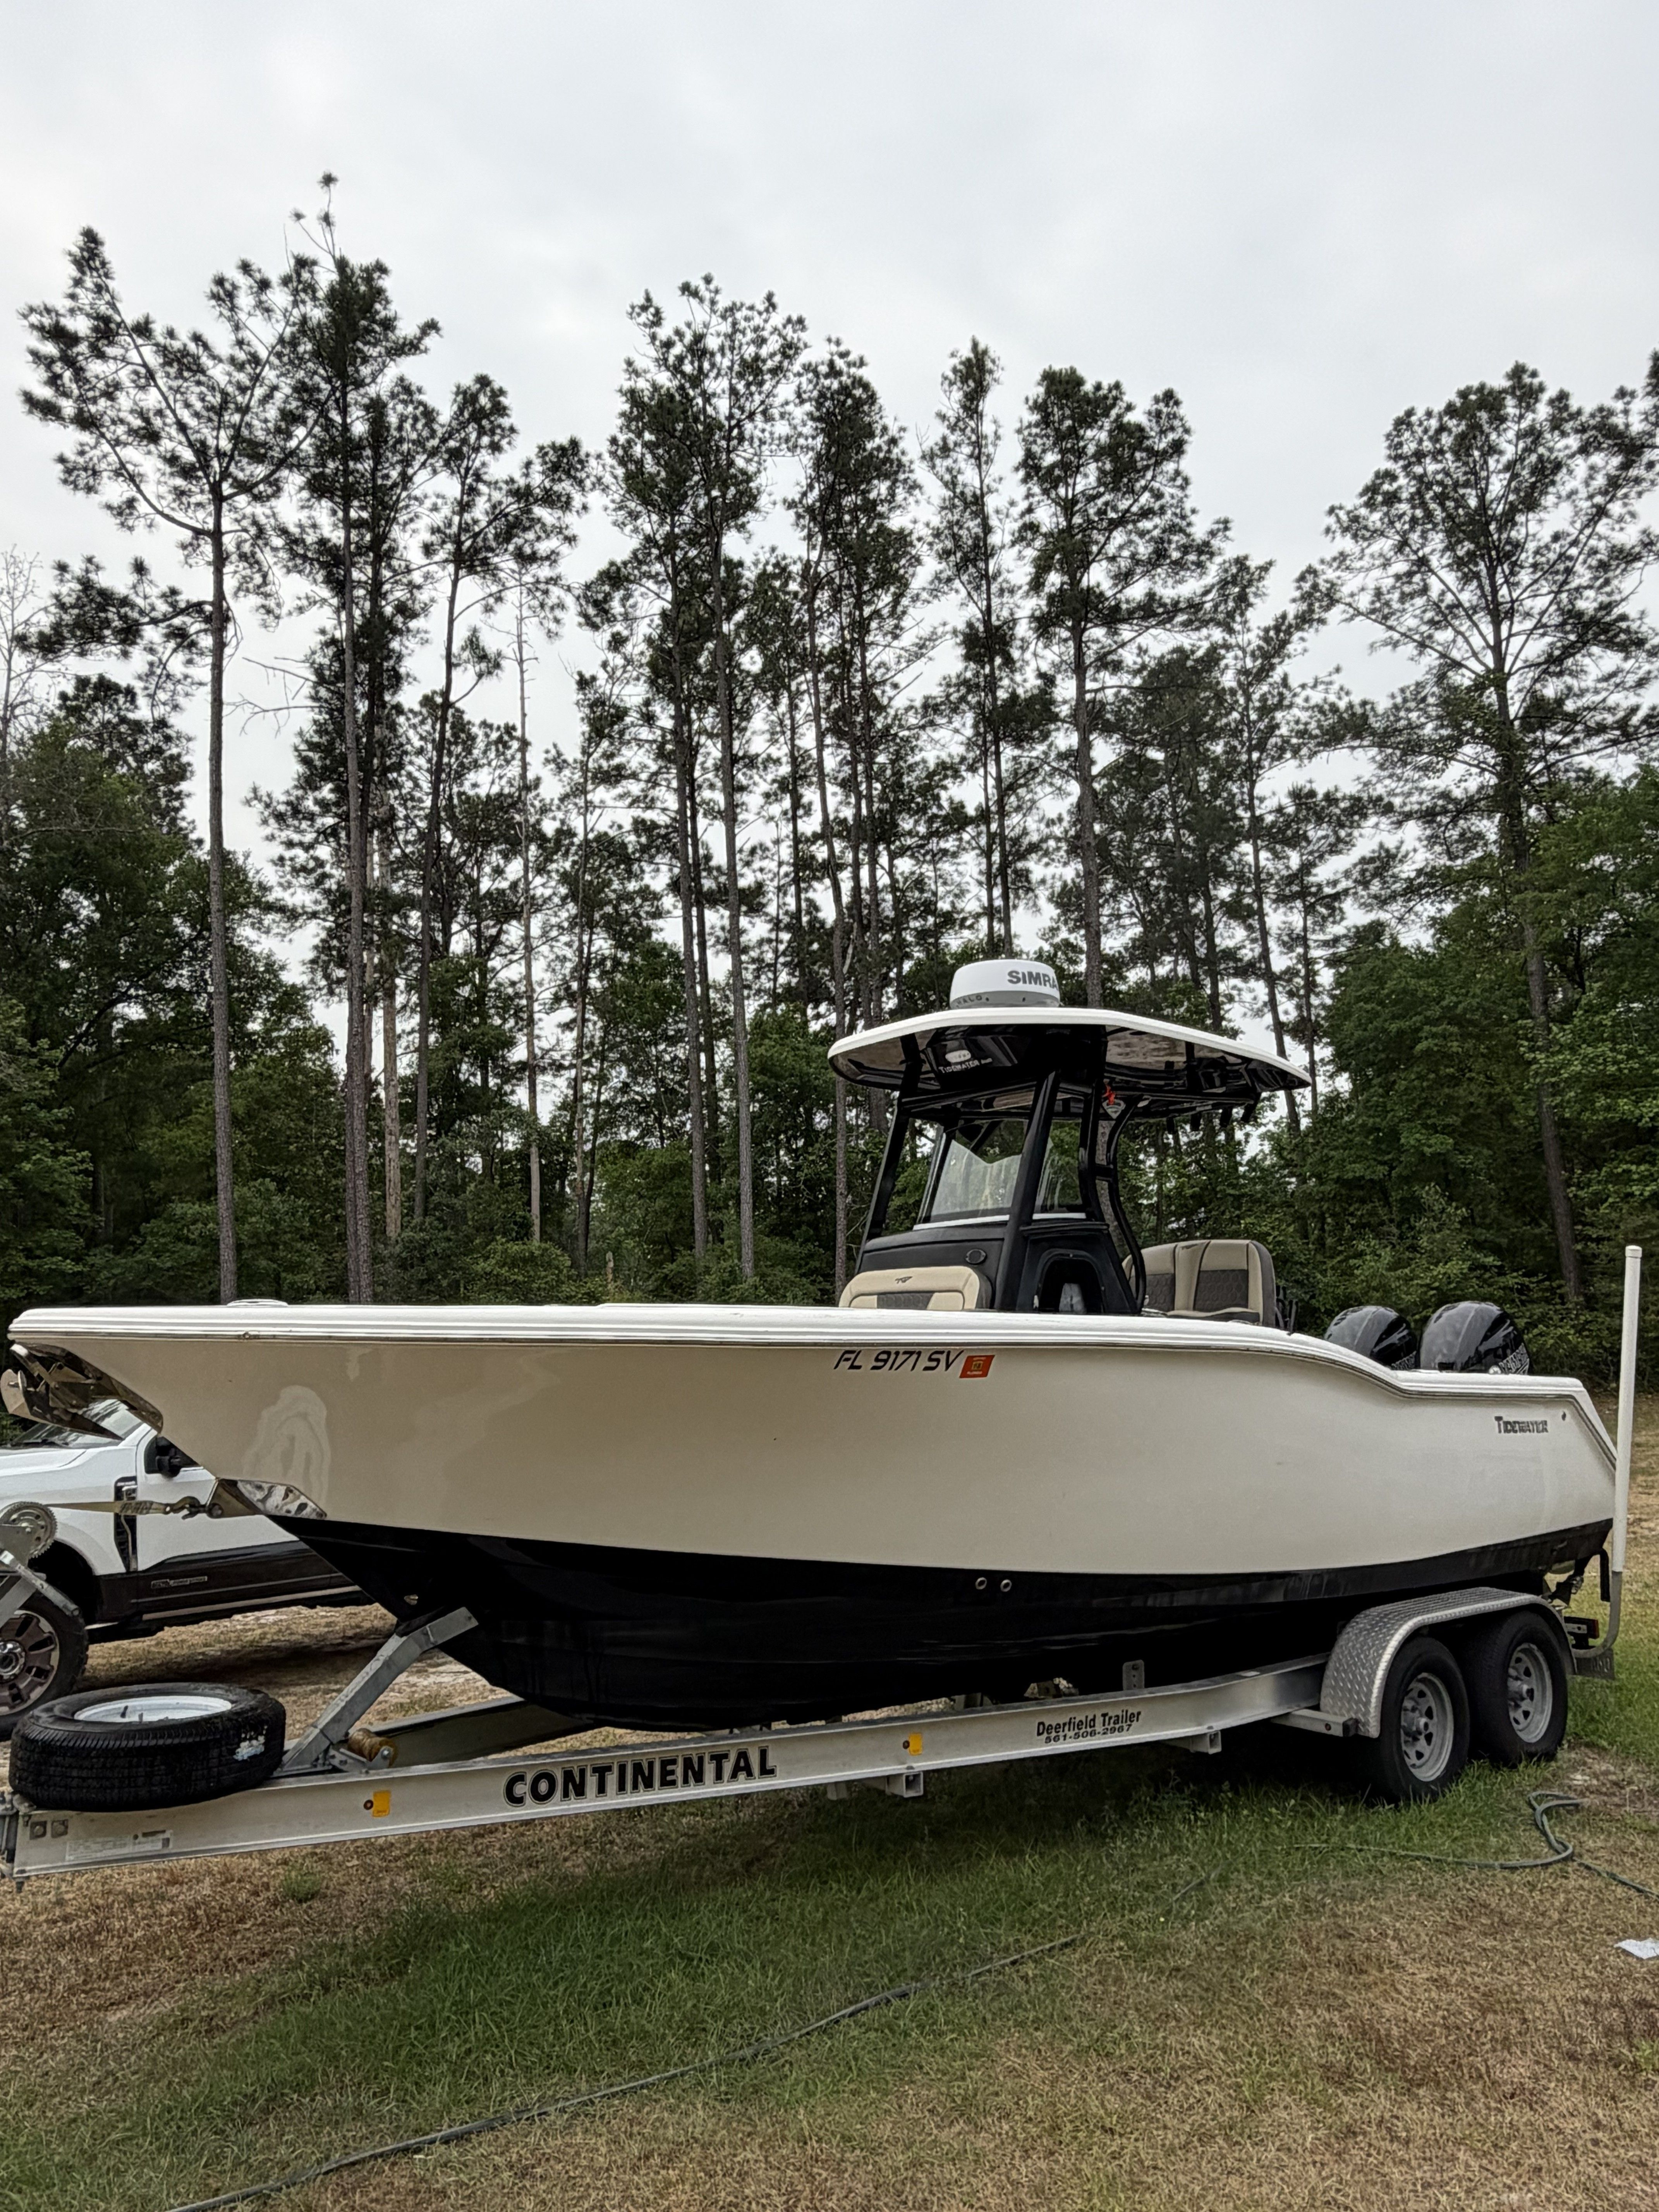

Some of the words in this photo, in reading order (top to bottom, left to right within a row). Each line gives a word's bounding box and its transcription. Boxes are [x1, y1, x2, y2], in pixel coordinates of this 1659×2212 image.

[833, 1350, 863, 1370] FL
[870, 1350, 922, 1372] 9171
[922, 1350, 965, 1372] SV
[1036, 1714, 1096, 1736] Deerfield
[1101, 1709, 1142, 1727] Trailer
[504, 1745, 777, 1807] CONTINENTAL
